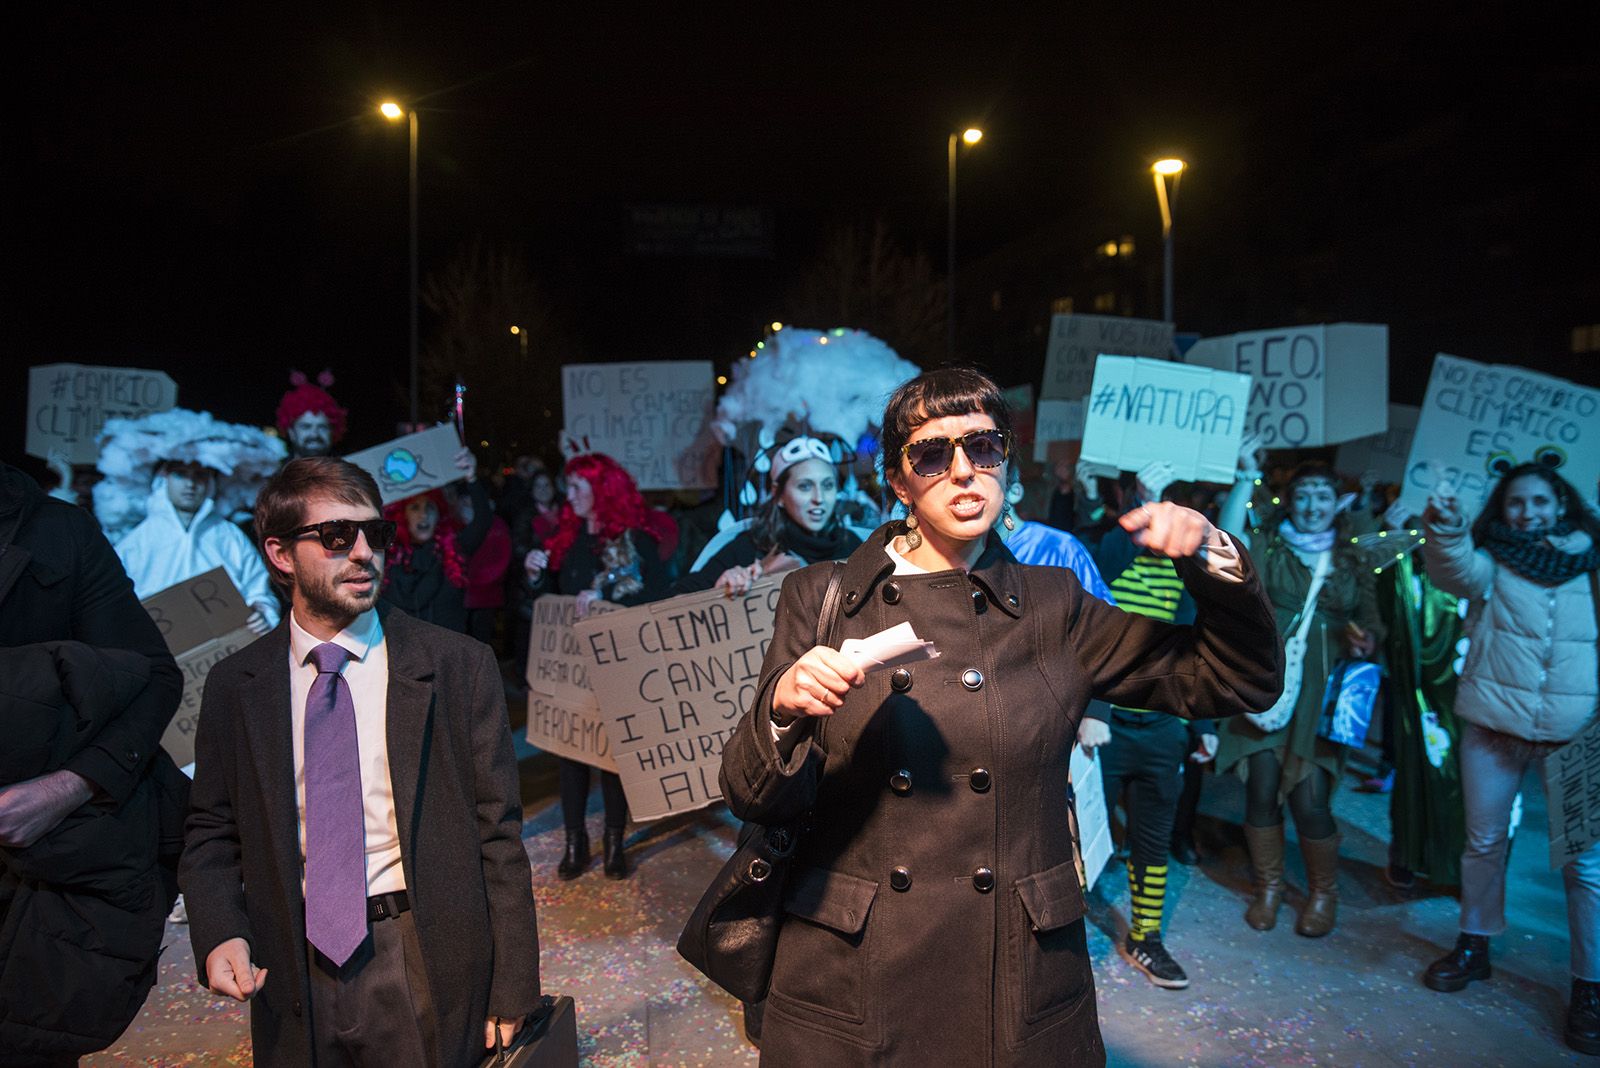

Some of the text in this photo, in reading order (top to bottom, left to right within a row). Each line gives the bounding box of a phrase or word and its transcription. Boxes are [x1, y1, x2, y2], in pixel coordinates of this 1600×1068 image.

[1236, 334, 1322, 381] ECO,
[50, 370, 163, 408] #CAMBIO
[568, 366, 650, 398] NO ES
[1249, 381, 1308, 410] NO
[1435, 360, 1469, 385] NO
[1468, 370, 1500, 396] ES
[1091, 383, 1236, 437] #NATURA
[624, 438, 655, 461] ES
[588, 629, 628, 666] EL
[638, 603, 731, 654] CLIMA
[533, 699, 613, 758] PERDEMO
[615, 713, 644, 744] I
[659, 701, 700, 735] LA
